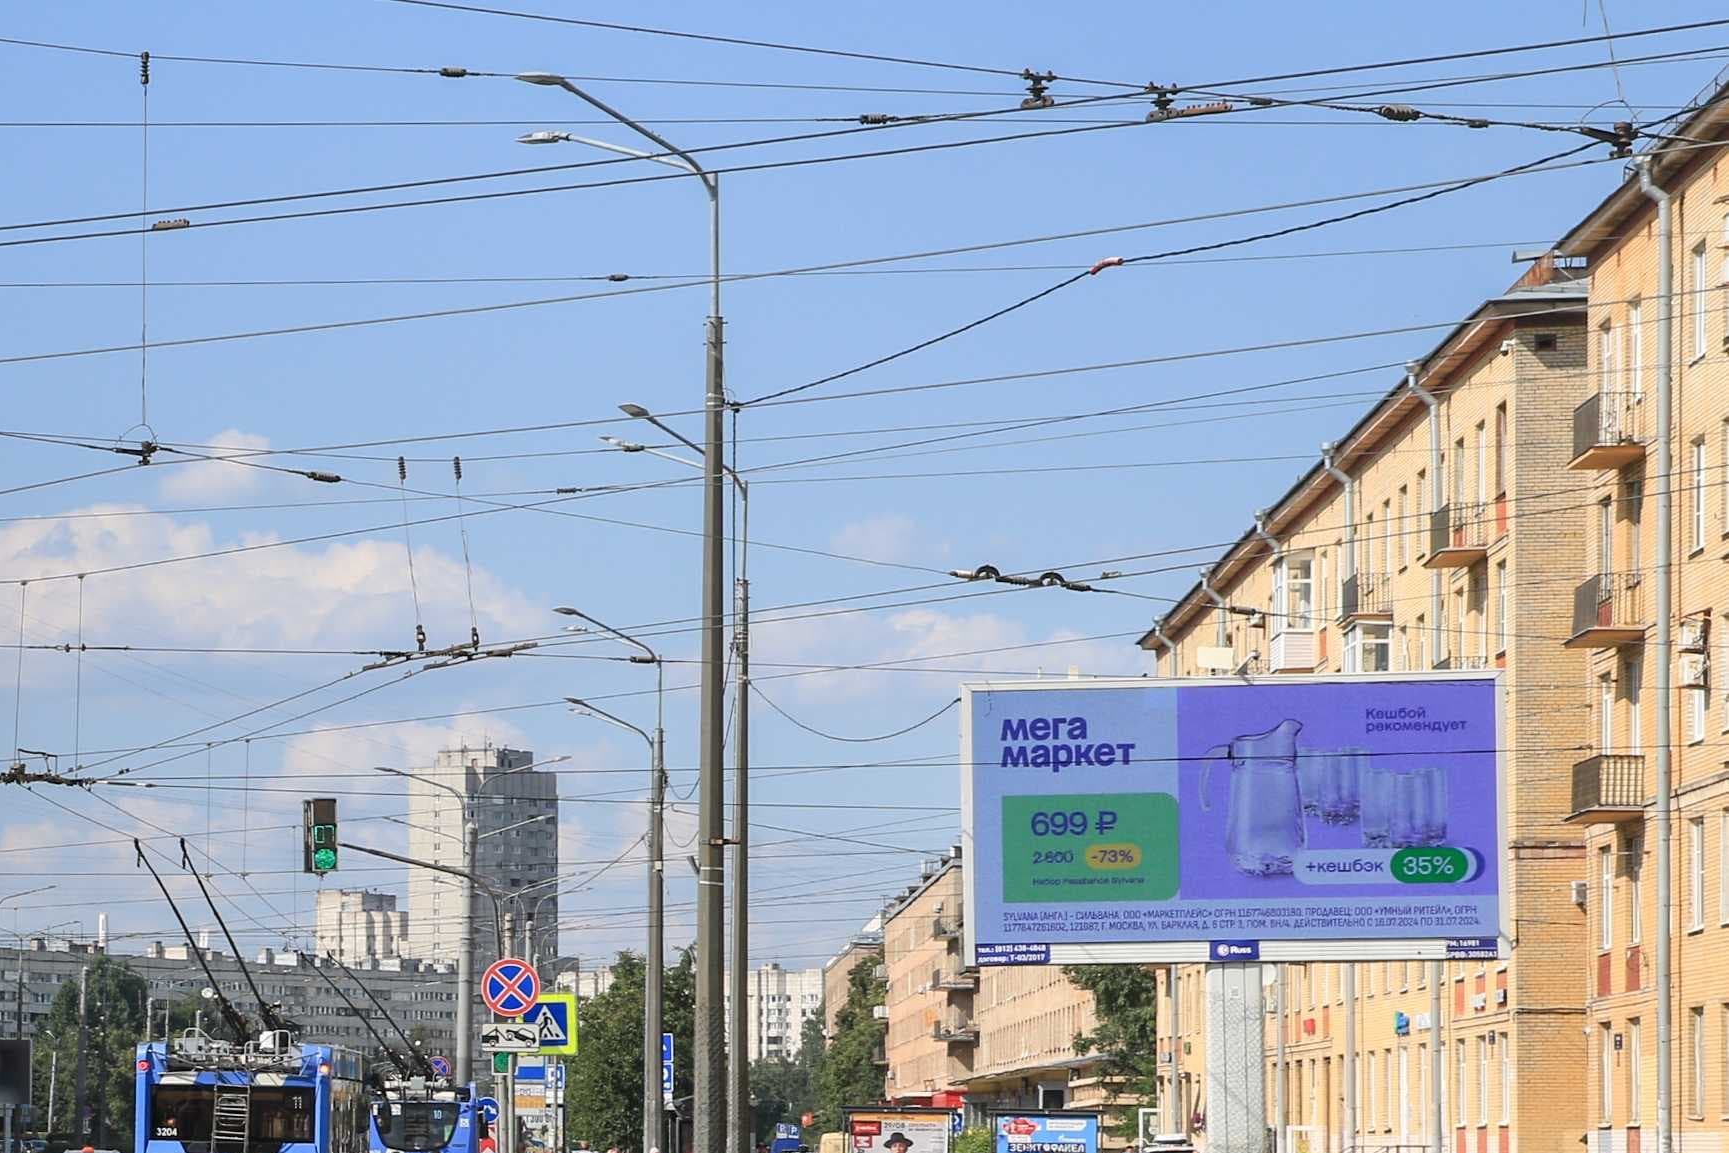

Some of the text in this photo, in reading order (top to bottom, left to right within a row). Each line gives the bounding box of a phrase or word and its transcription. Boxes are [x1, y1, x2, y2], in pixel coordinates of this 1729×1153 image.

[1365, 706, 1426, 720] Кешбой
[1000, 717, 1087, 741] мега
[1365, 721, 1467, 734] рекомендует
[1000, 743, 1136, 772] маркет
[1031, 811, 1088, 836] 699
[1403, 856, 1454, 875] 35%
[156, 1127, 178, 1137] 3204
